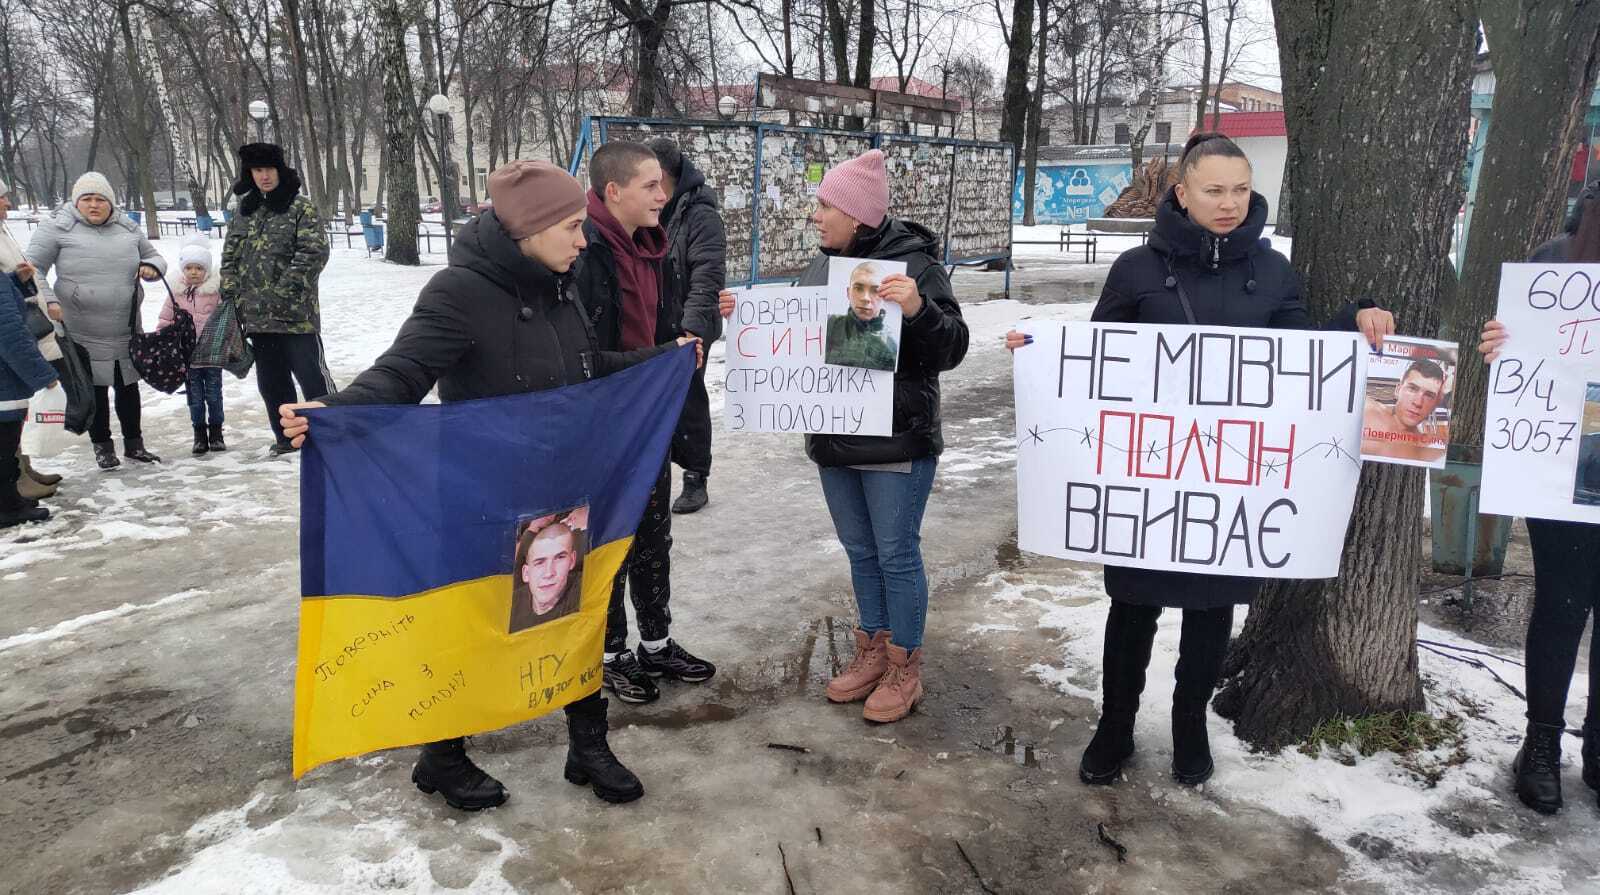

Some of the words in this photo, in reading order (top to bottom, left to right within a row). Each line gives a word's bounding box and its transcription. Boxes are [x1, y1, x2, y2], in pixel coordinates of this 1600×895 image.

[1528, 270, 1600, 312] 60
[737, 326, 823, 358] СИН
[725, 366, 876, 394] СТРОКОВИКА
[1057, 325, 1138, 402] НЕ
[1153, 331, 1358, 413] МОВЧИ
[758, 402, 865, 433] ПОЛОНУ
[1491, 417, 1578, 455] 3057
[1097, 410, 1297, 489] ПОЛОН
[1064, 481, 1298, 569] ВБИВАЄ
[520, 652, 568, 692] НГУ
